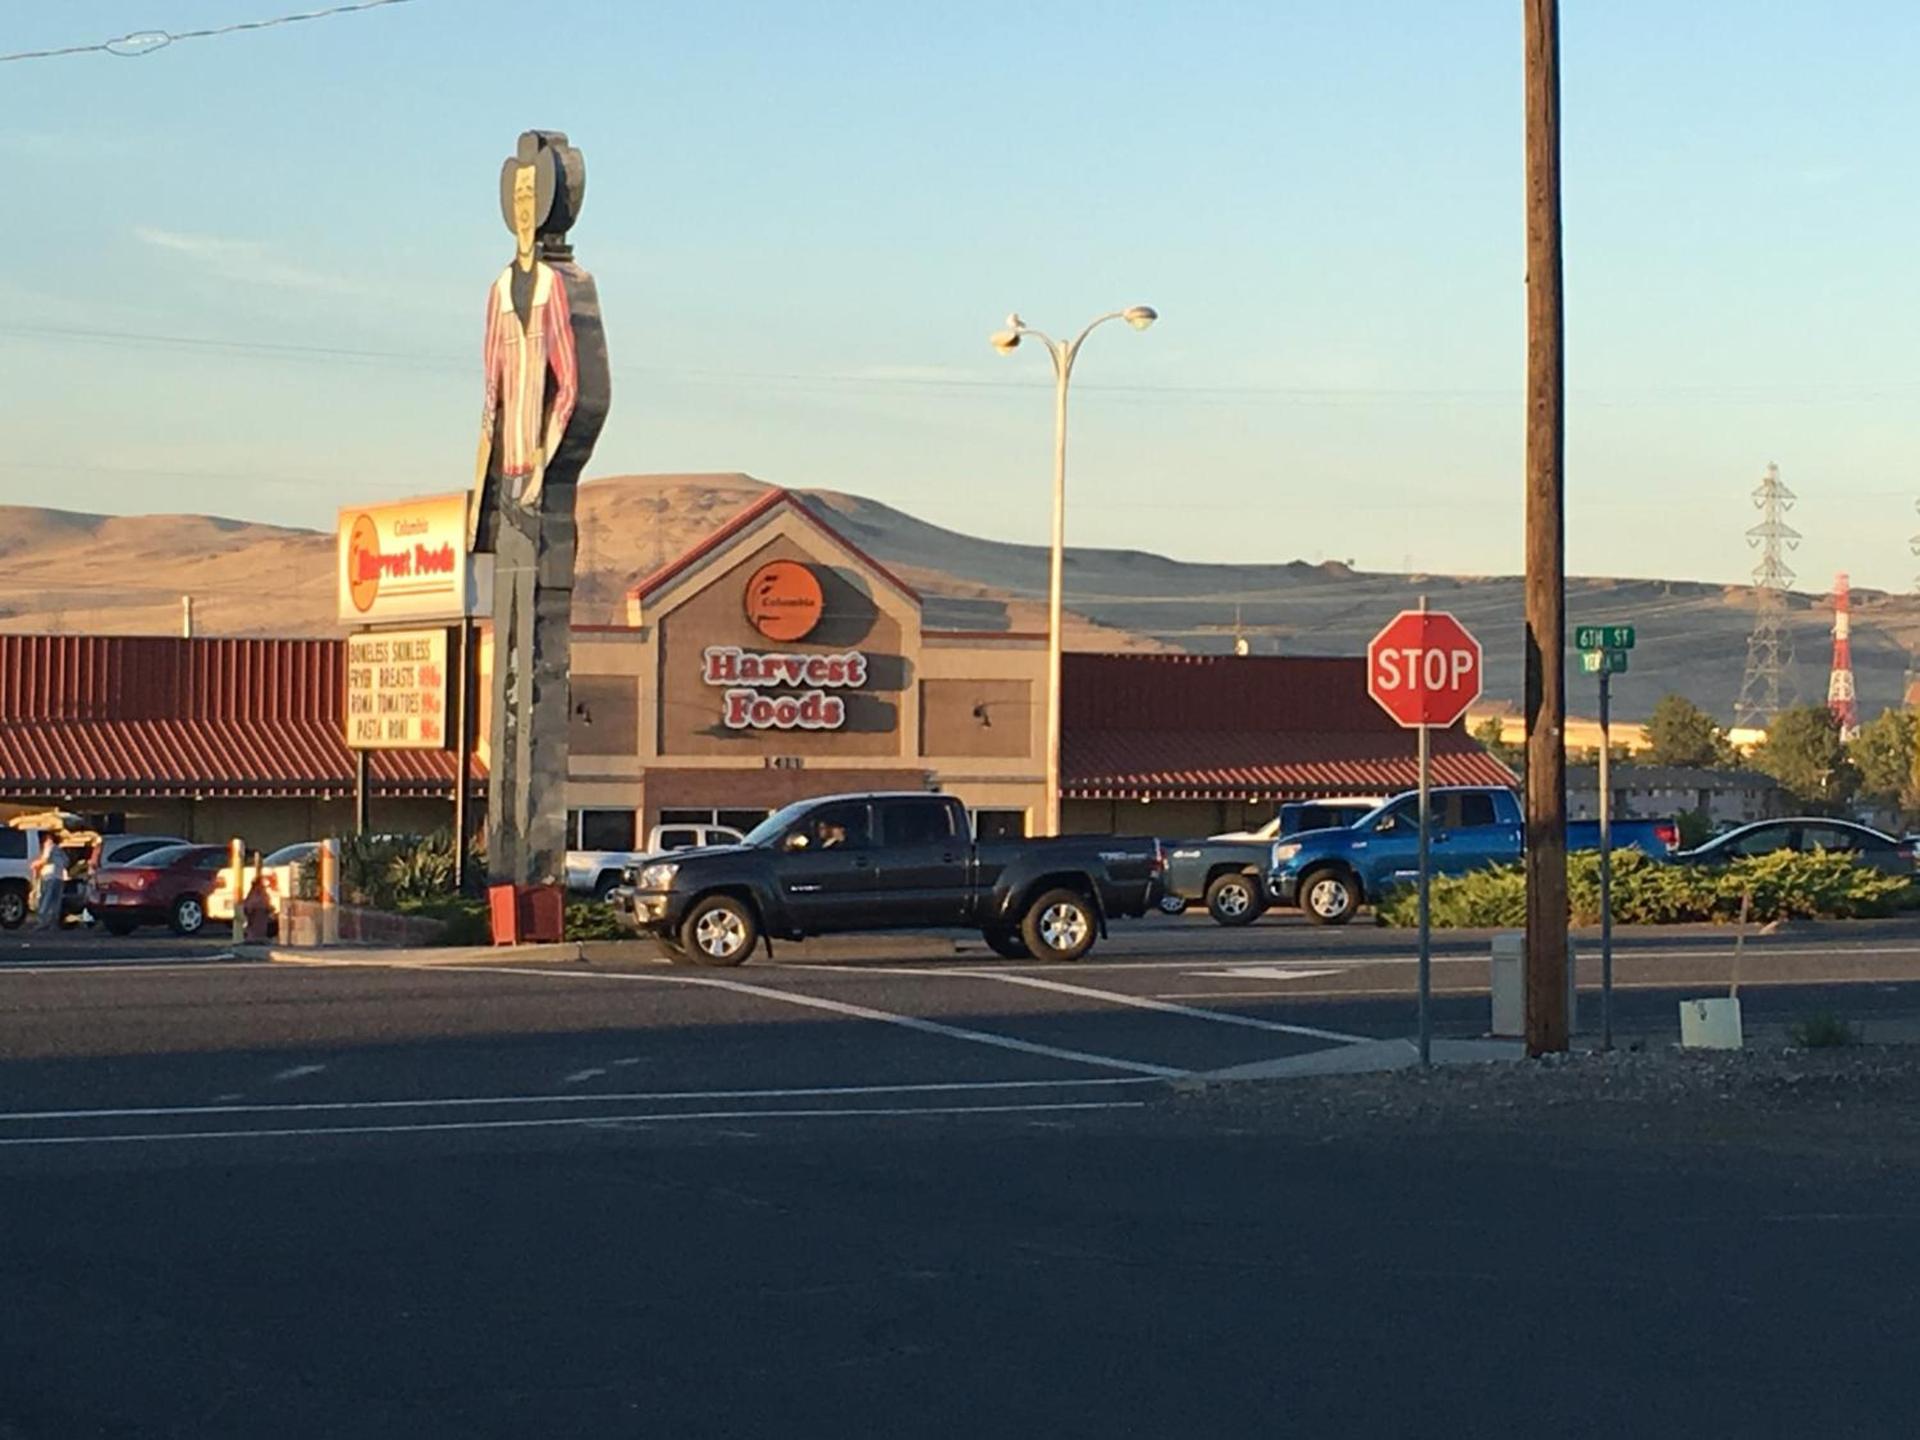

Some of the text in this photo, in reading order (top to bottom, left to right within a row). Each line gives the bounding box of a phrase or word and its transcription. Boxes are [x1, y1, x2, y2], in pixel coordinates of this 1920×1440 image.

[415, 542, 454, 575] Foods
[1580, 630, 1629, 647] 6TH ST
[704, 646, 867, 687] Harvest
[1377, 648, 1473, 691] STOP
[724, 689, 845, 729] Foods
[357, 719, 382, 740] PASTA
